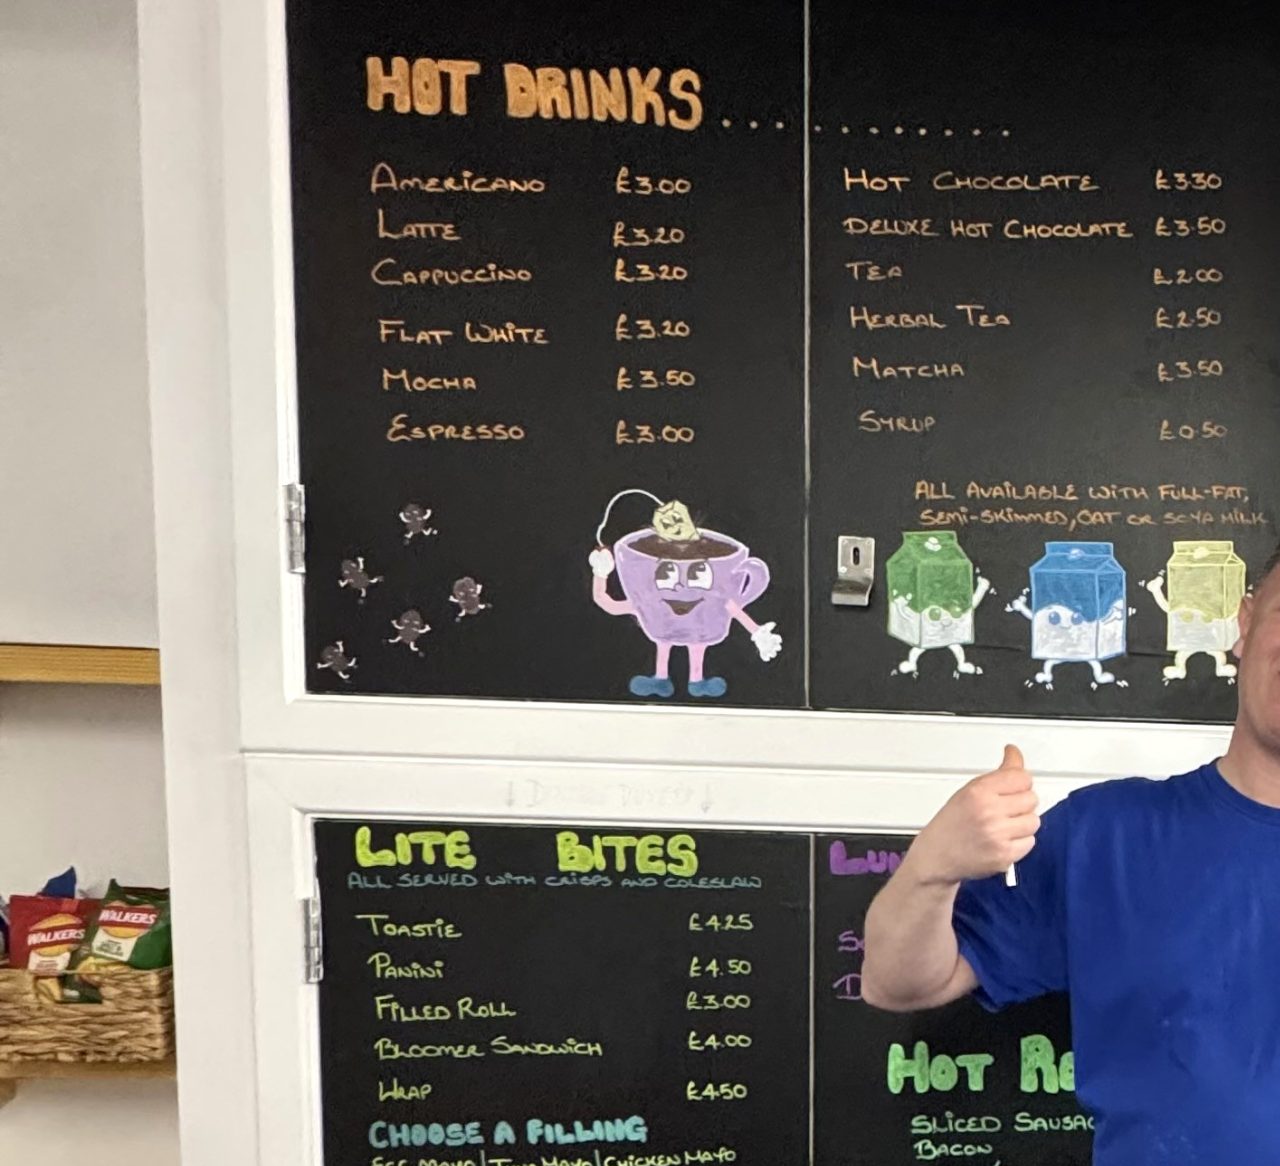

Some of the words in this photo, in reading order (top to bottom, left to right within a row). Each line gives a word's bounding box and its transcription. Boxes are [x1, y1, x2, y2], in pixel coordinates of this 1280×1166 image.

[367, 57, 480, 115] HOT
[504, 63, 702, 130] DRINKS
[99, 909, 158, 924] WALKERS
[27, 928, 85, 946] WALKERS
